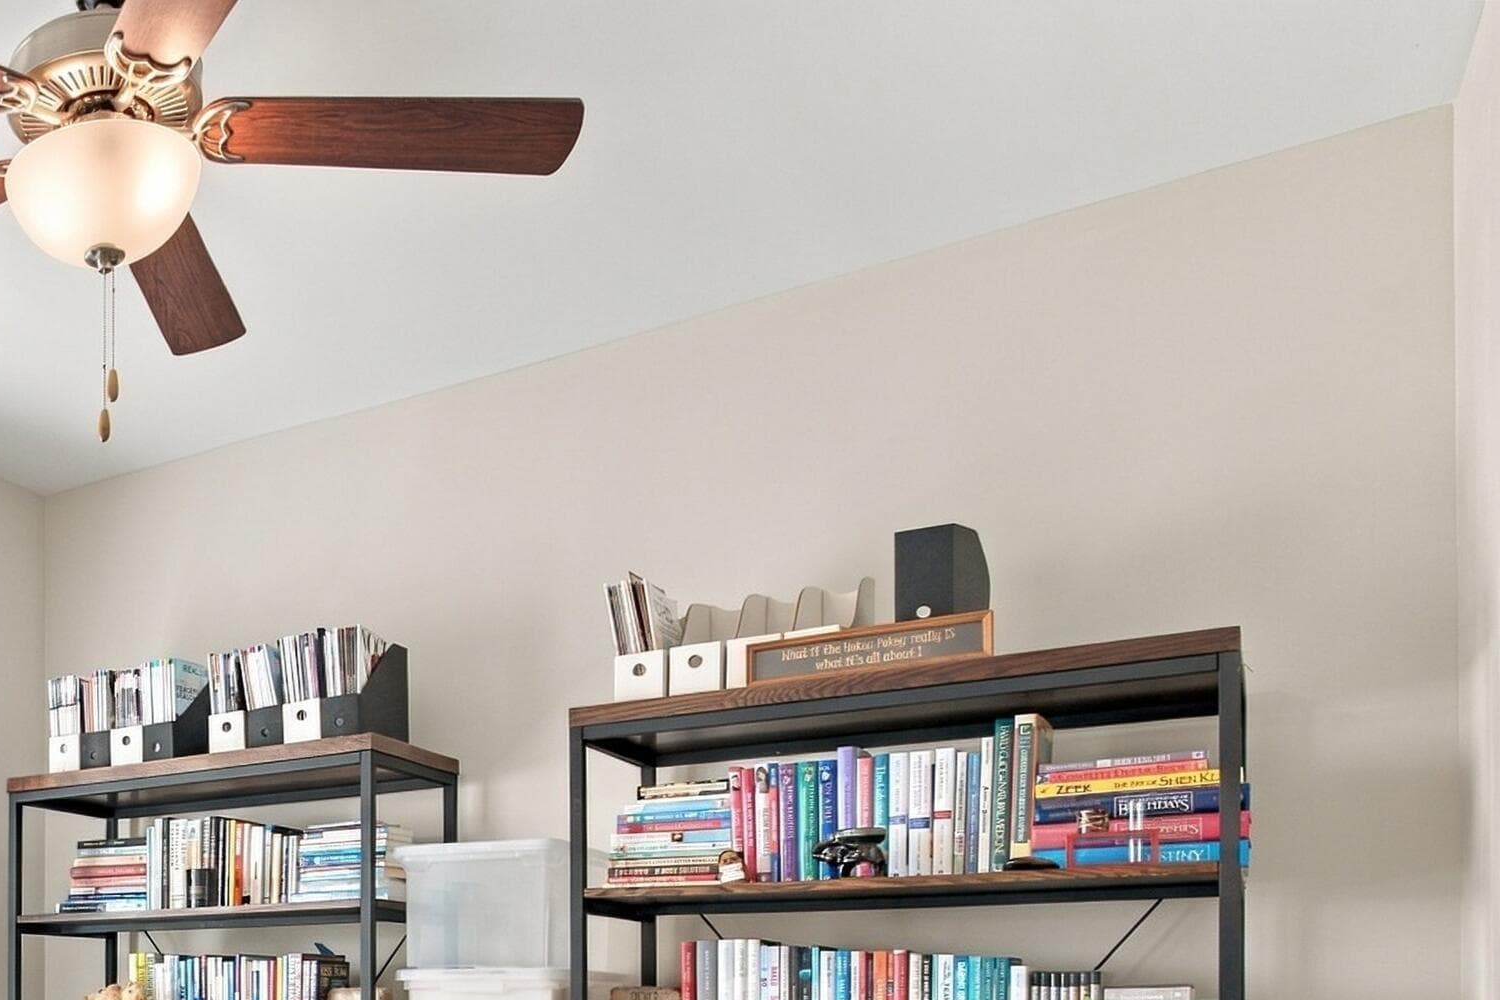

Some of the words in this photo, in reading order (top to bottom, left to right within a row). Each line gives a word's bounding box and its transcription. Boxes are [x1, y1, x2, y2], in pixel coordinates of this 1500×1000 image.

[824, 643, 842, 655] the
[910, 631, 942, 646] really
[866, 651, 882, 664] all
